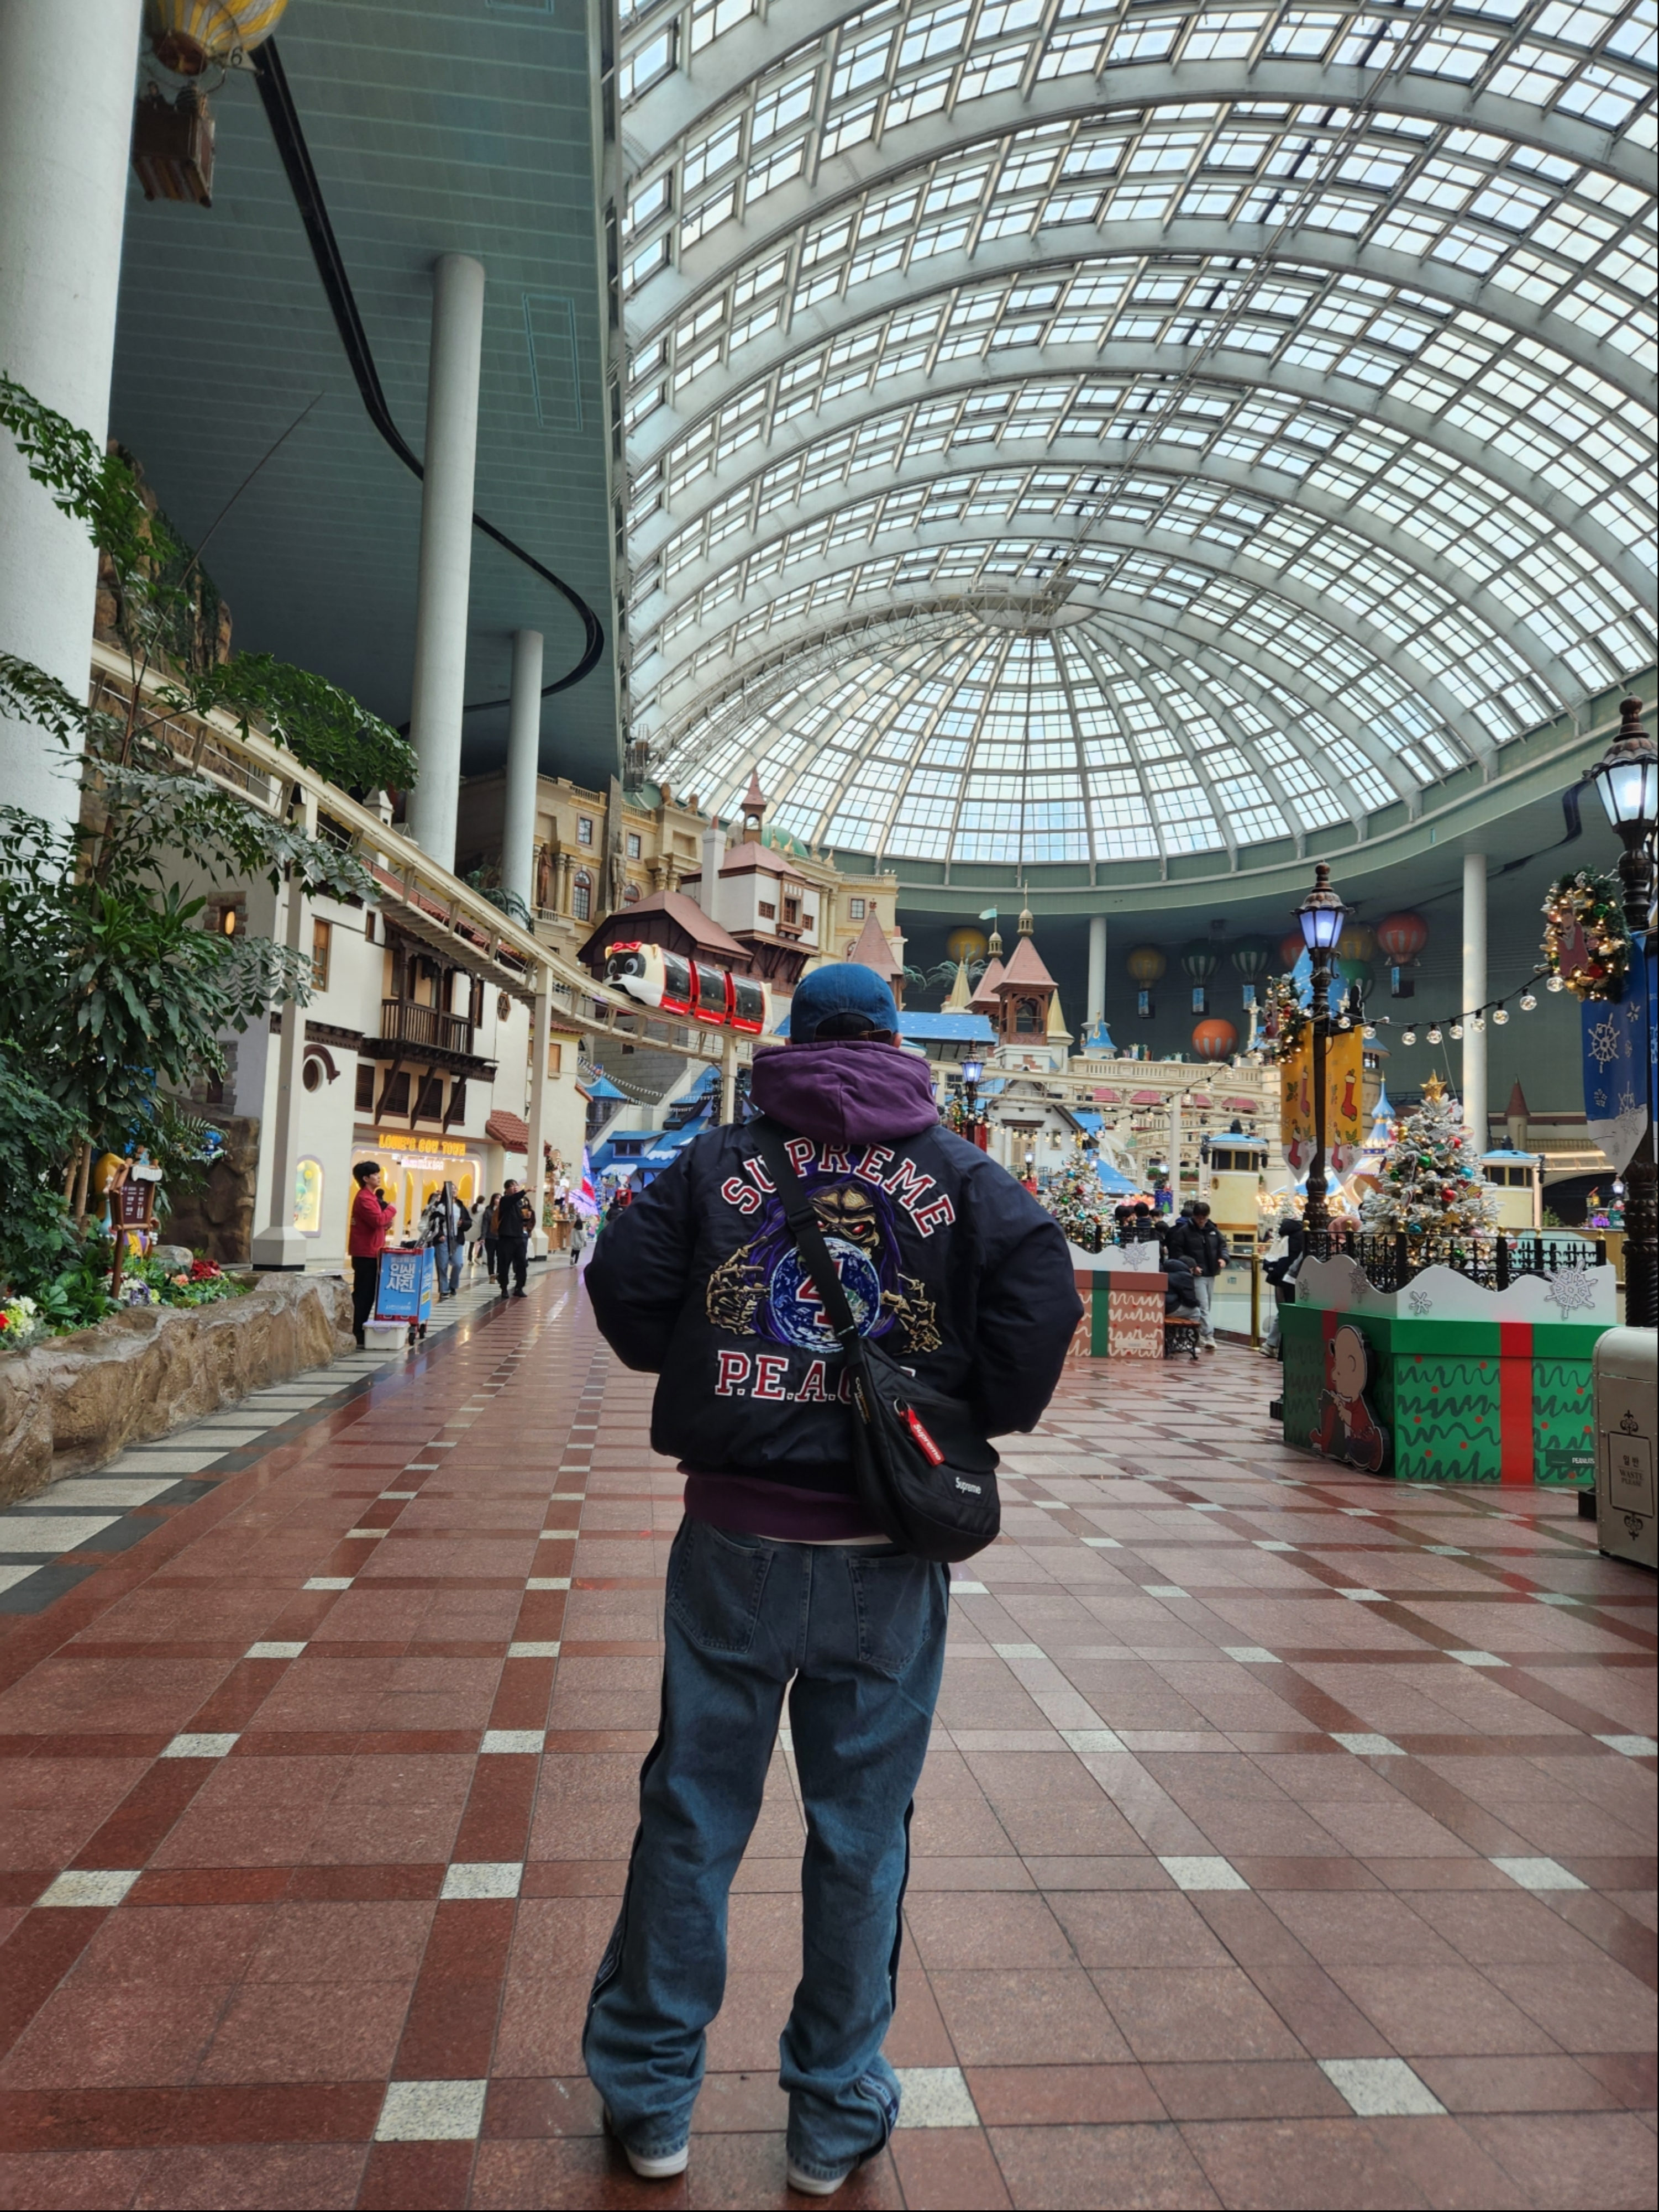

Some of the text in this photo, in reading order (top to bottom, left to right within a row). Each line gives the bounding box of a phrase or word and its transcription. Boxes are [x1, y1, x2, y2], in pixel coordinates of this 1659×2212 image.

[230, 46, 243, 66] 6
[418, 1139, 439, 1153] COW
[442, 1141, 466, 1156] TOWN
[721, 1136, 956, 1238] SUPREME
[390, 1263, 415, 1280] 인생
[386, 1277, 416, 1292] 사진
[914, 1423, 941, 1461] Supreme
[1623, 1455, 1639, 1468] 일반
[1619, 1469, 1644, 1480] WASTE
[1621, 1477, 1642, 1488] PLEASE
[955, 1477, 982, 1494] Supreme
